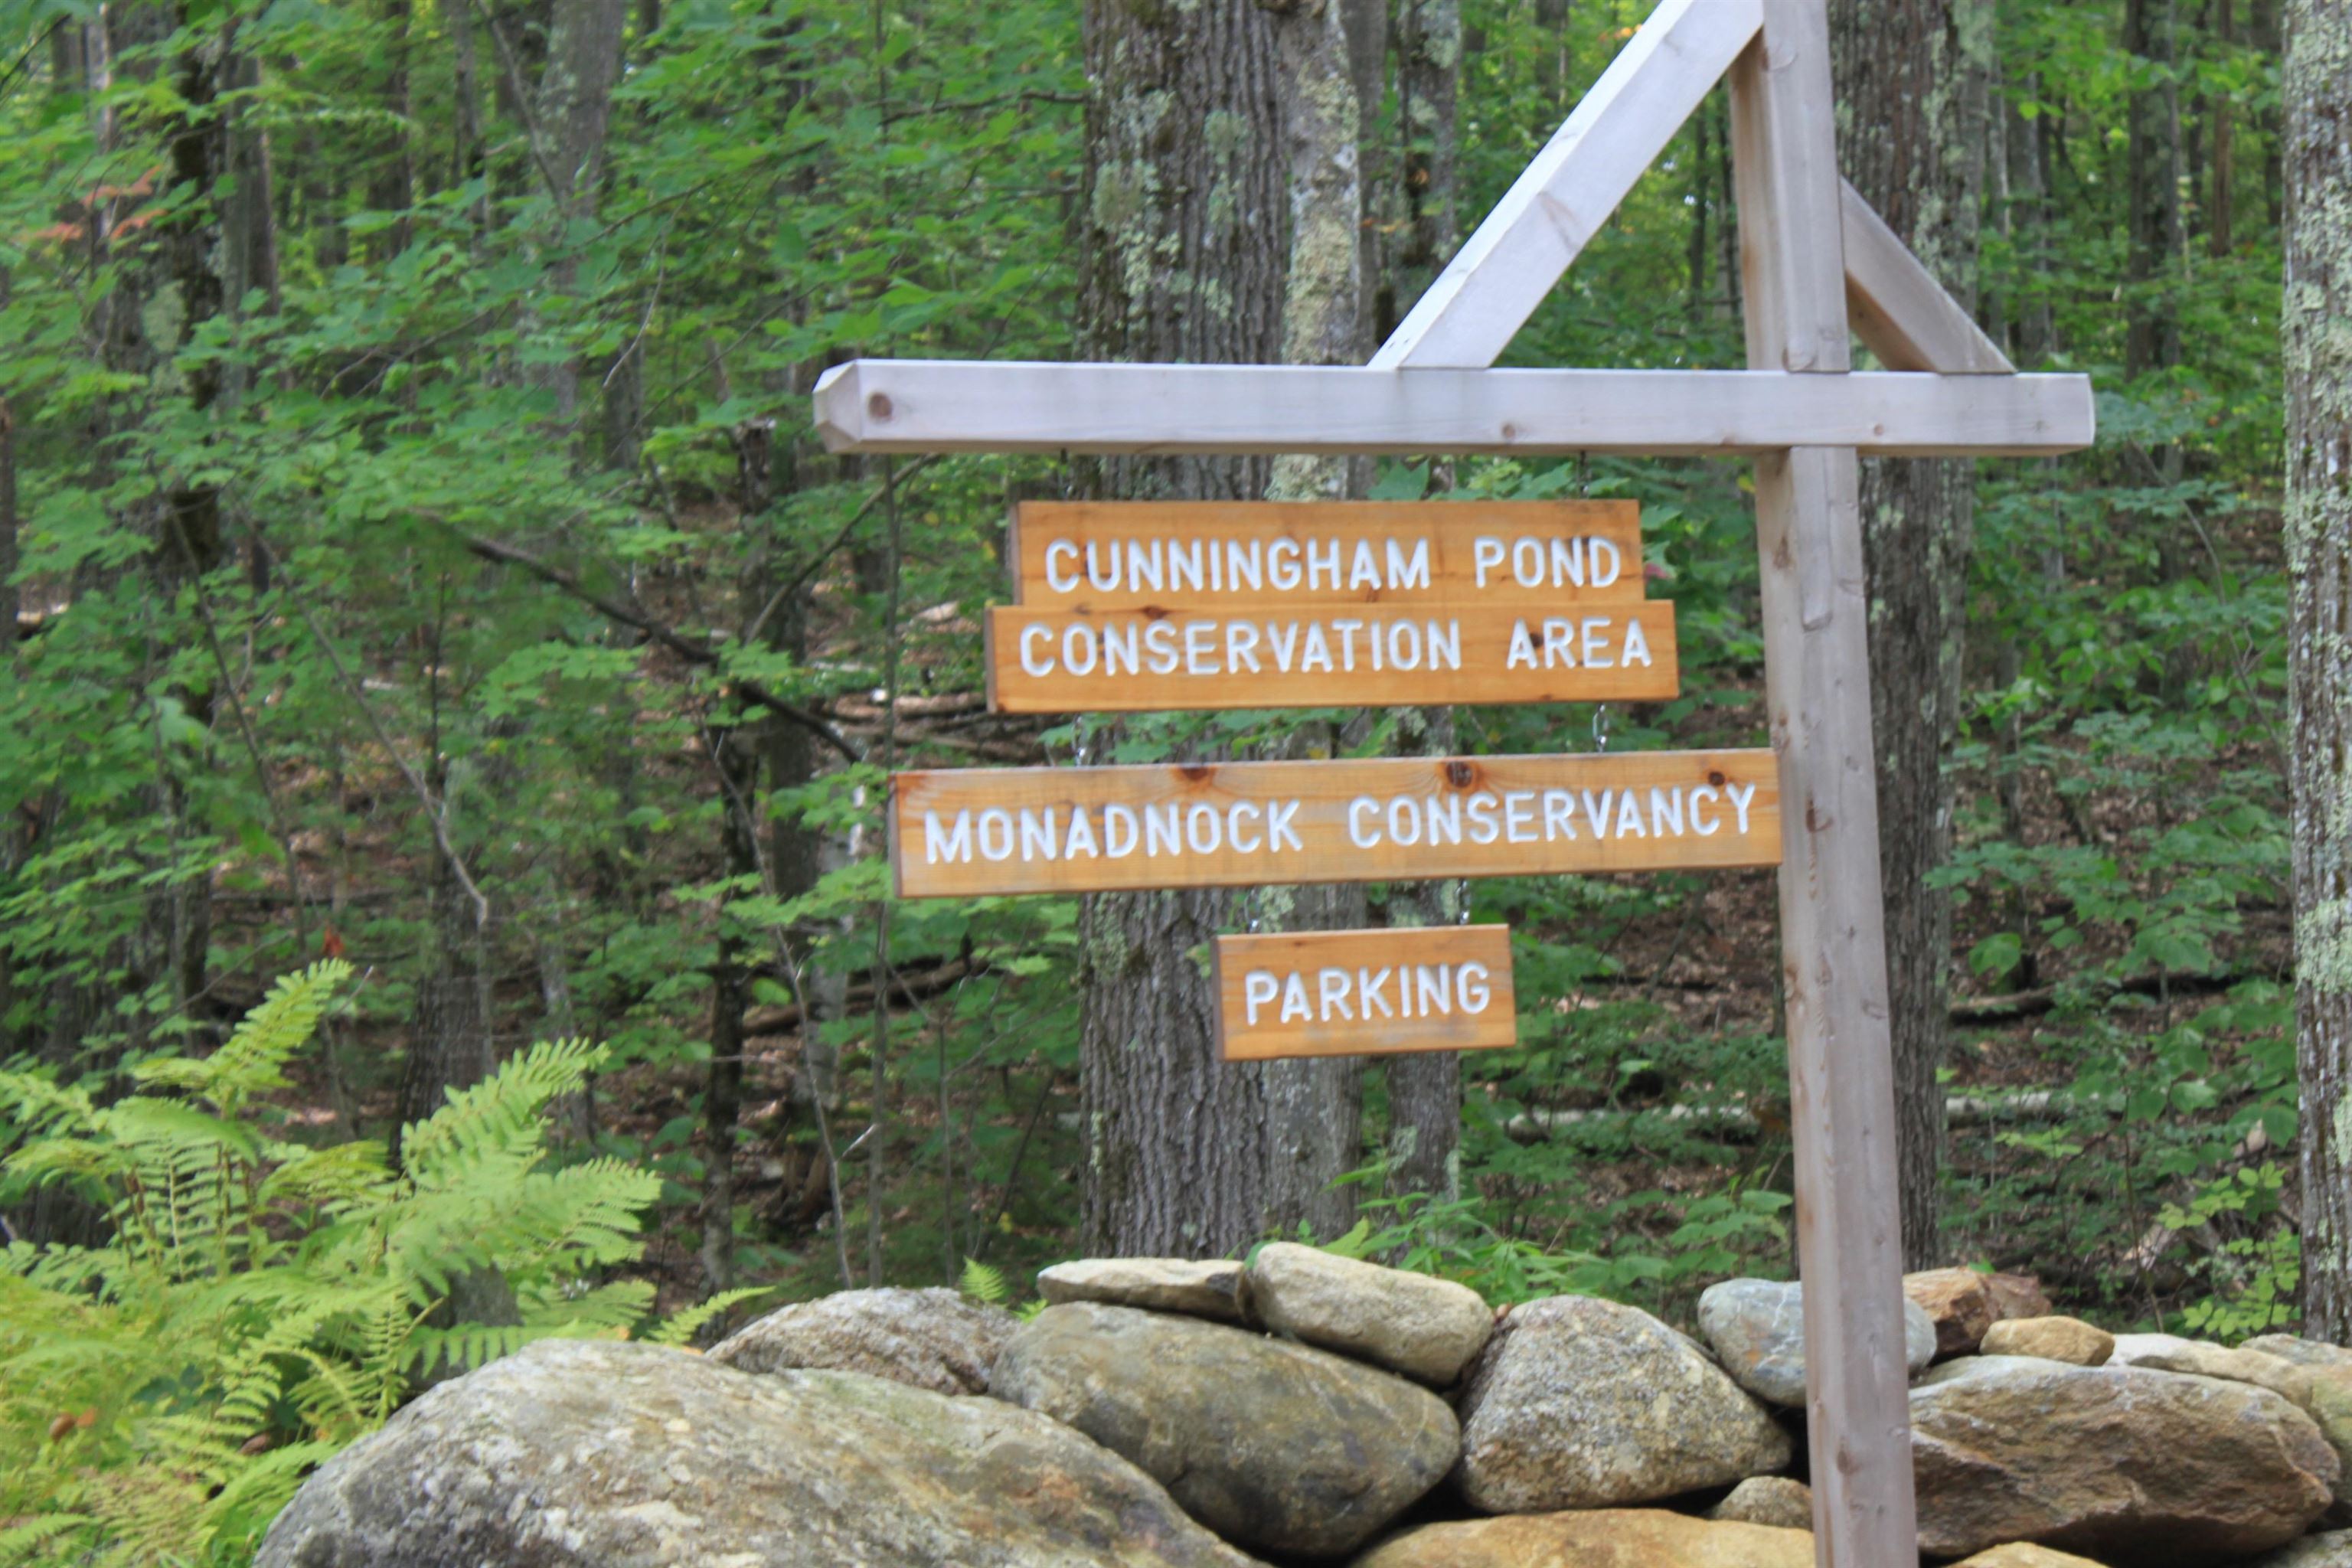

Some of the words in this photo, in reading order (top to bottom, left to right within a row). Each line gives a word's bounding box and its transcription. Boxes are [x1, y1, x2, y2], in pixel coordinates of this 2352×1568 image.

[1045, 536, 1431, 593] CUNNINGHAM
[1474, 535, 1621, 589] POND
[1020, 619, 1462, 678] CONSERVATION
[1507, 617, 1652, 670] AREA
[925, 799, 1303, 864] MONADNOCK
[1348, 783, 1756, 849] CONSERVANCY
[1245, 961, 1491, 1025] PARKING
